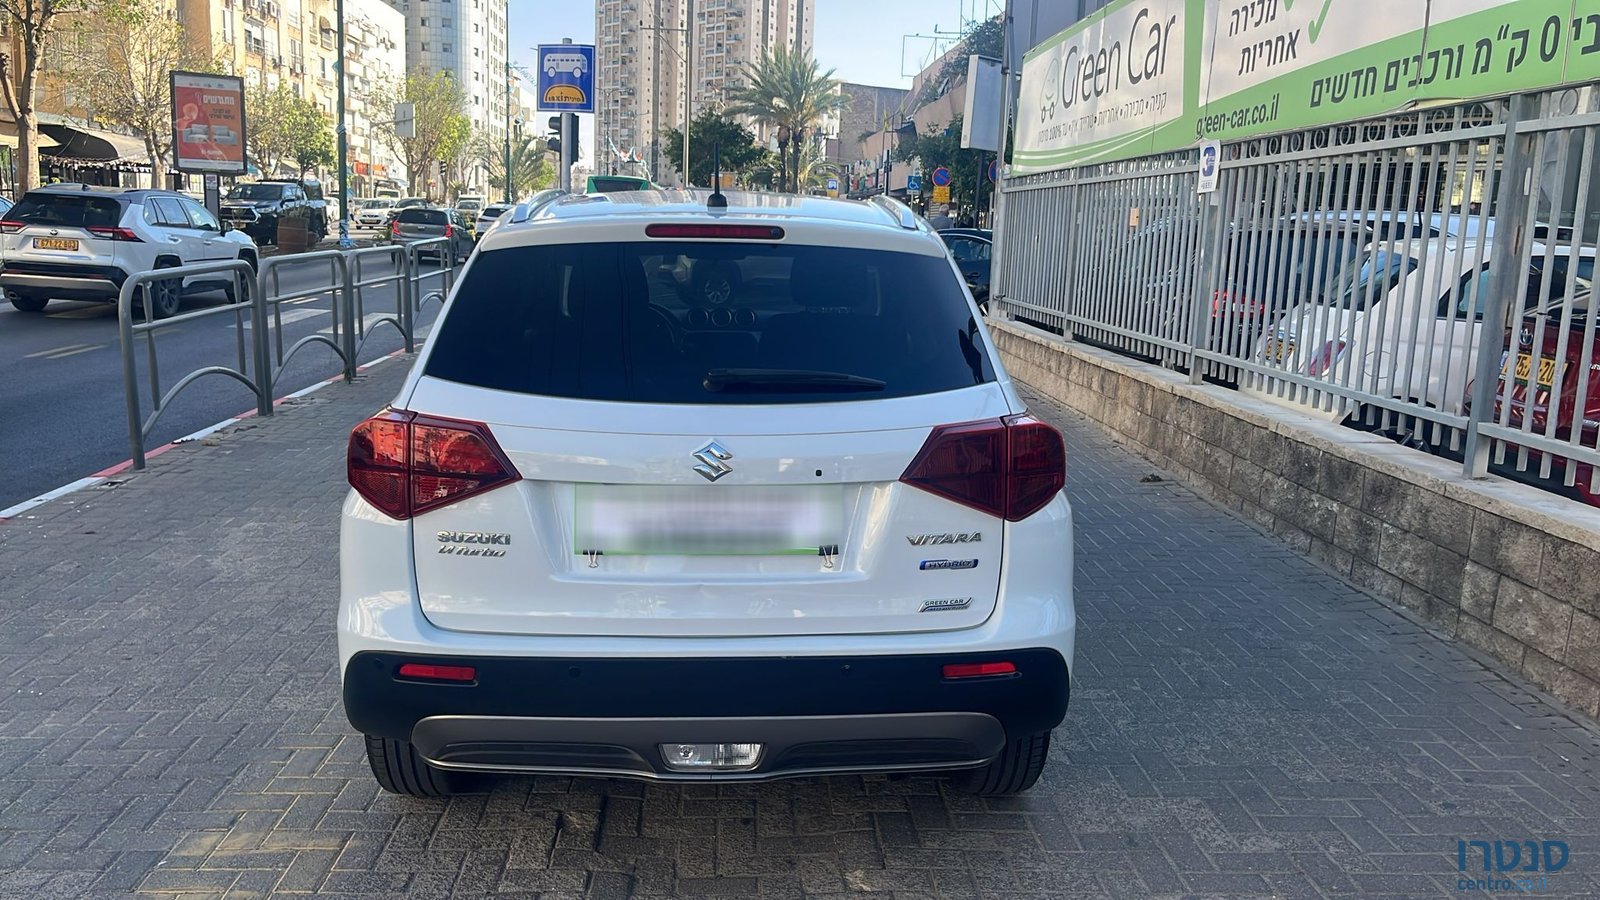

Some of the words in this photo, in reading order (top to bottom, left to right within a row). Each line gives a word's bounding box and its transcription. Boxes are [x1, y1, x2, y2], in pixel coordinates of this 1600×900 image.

[1229, 0, 1277, 37] מכירה
[1238, 29, 1301, 76] אחריות
[1540, 15, 1561, 63] 0
[1062, 40, 1121, 109] Green
[1127, 8, 1176, 85] Car
[1383, 44, 1465, 92] ורכבים
[1310, 66, 1377, 108] חדשים
[1098, 106, 1120, 126] אחריות
[1123, 99, 1144, 119] מכירה
[1150, 92, 1167, 115] קניה
[437, 531, 511, 545] SUZUKI
[906, 531, 982, 546] VITARA
[929, 560, 973, 569] HYBRID
